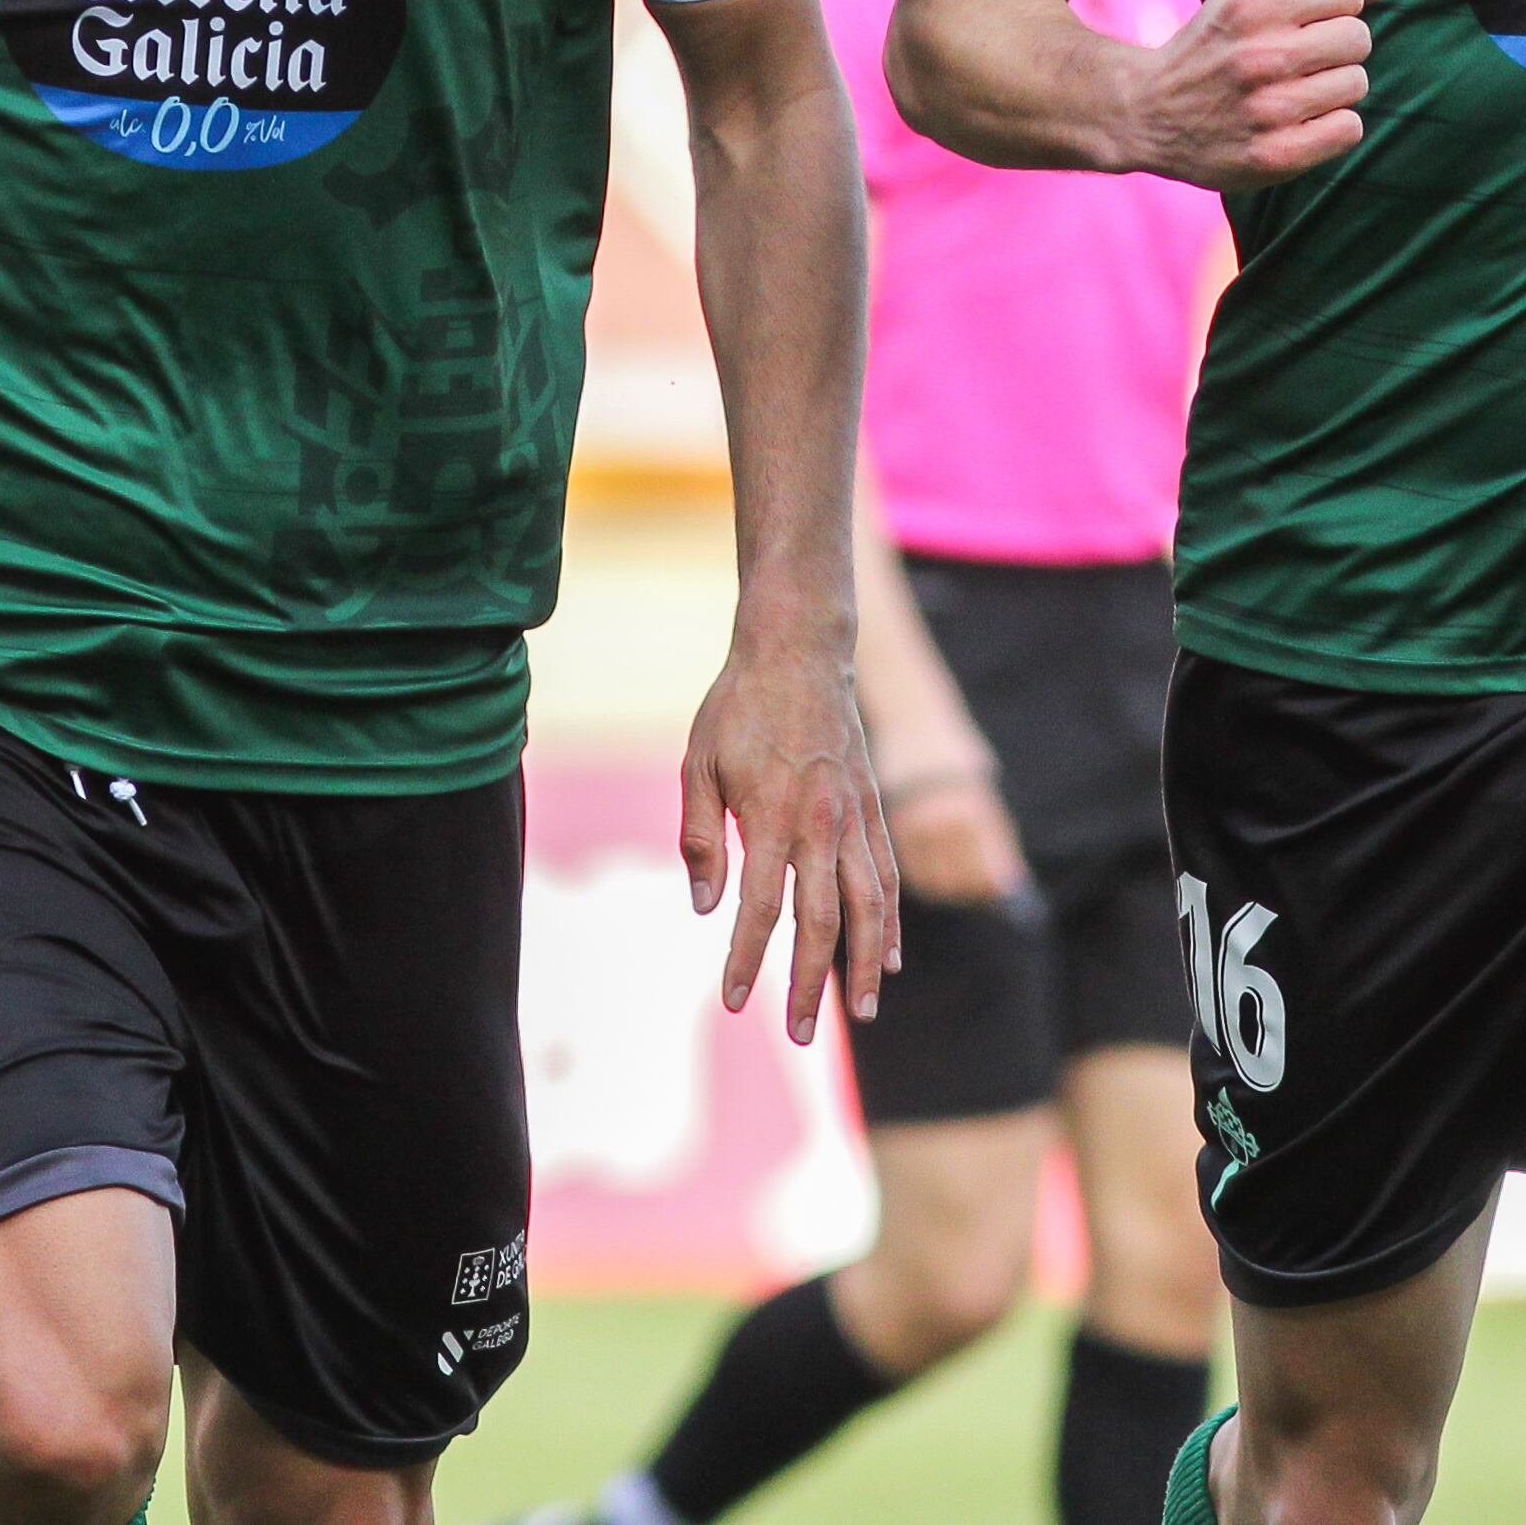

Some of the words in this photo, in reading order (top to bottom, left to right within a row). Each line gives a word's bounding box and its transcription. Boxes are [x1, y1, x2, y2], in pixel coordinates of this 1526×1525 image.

[72, 5, 327, 93] Galicia
[150, 95, 240, 157] 0,0
[1176, 870, 1286, 1092] 16
